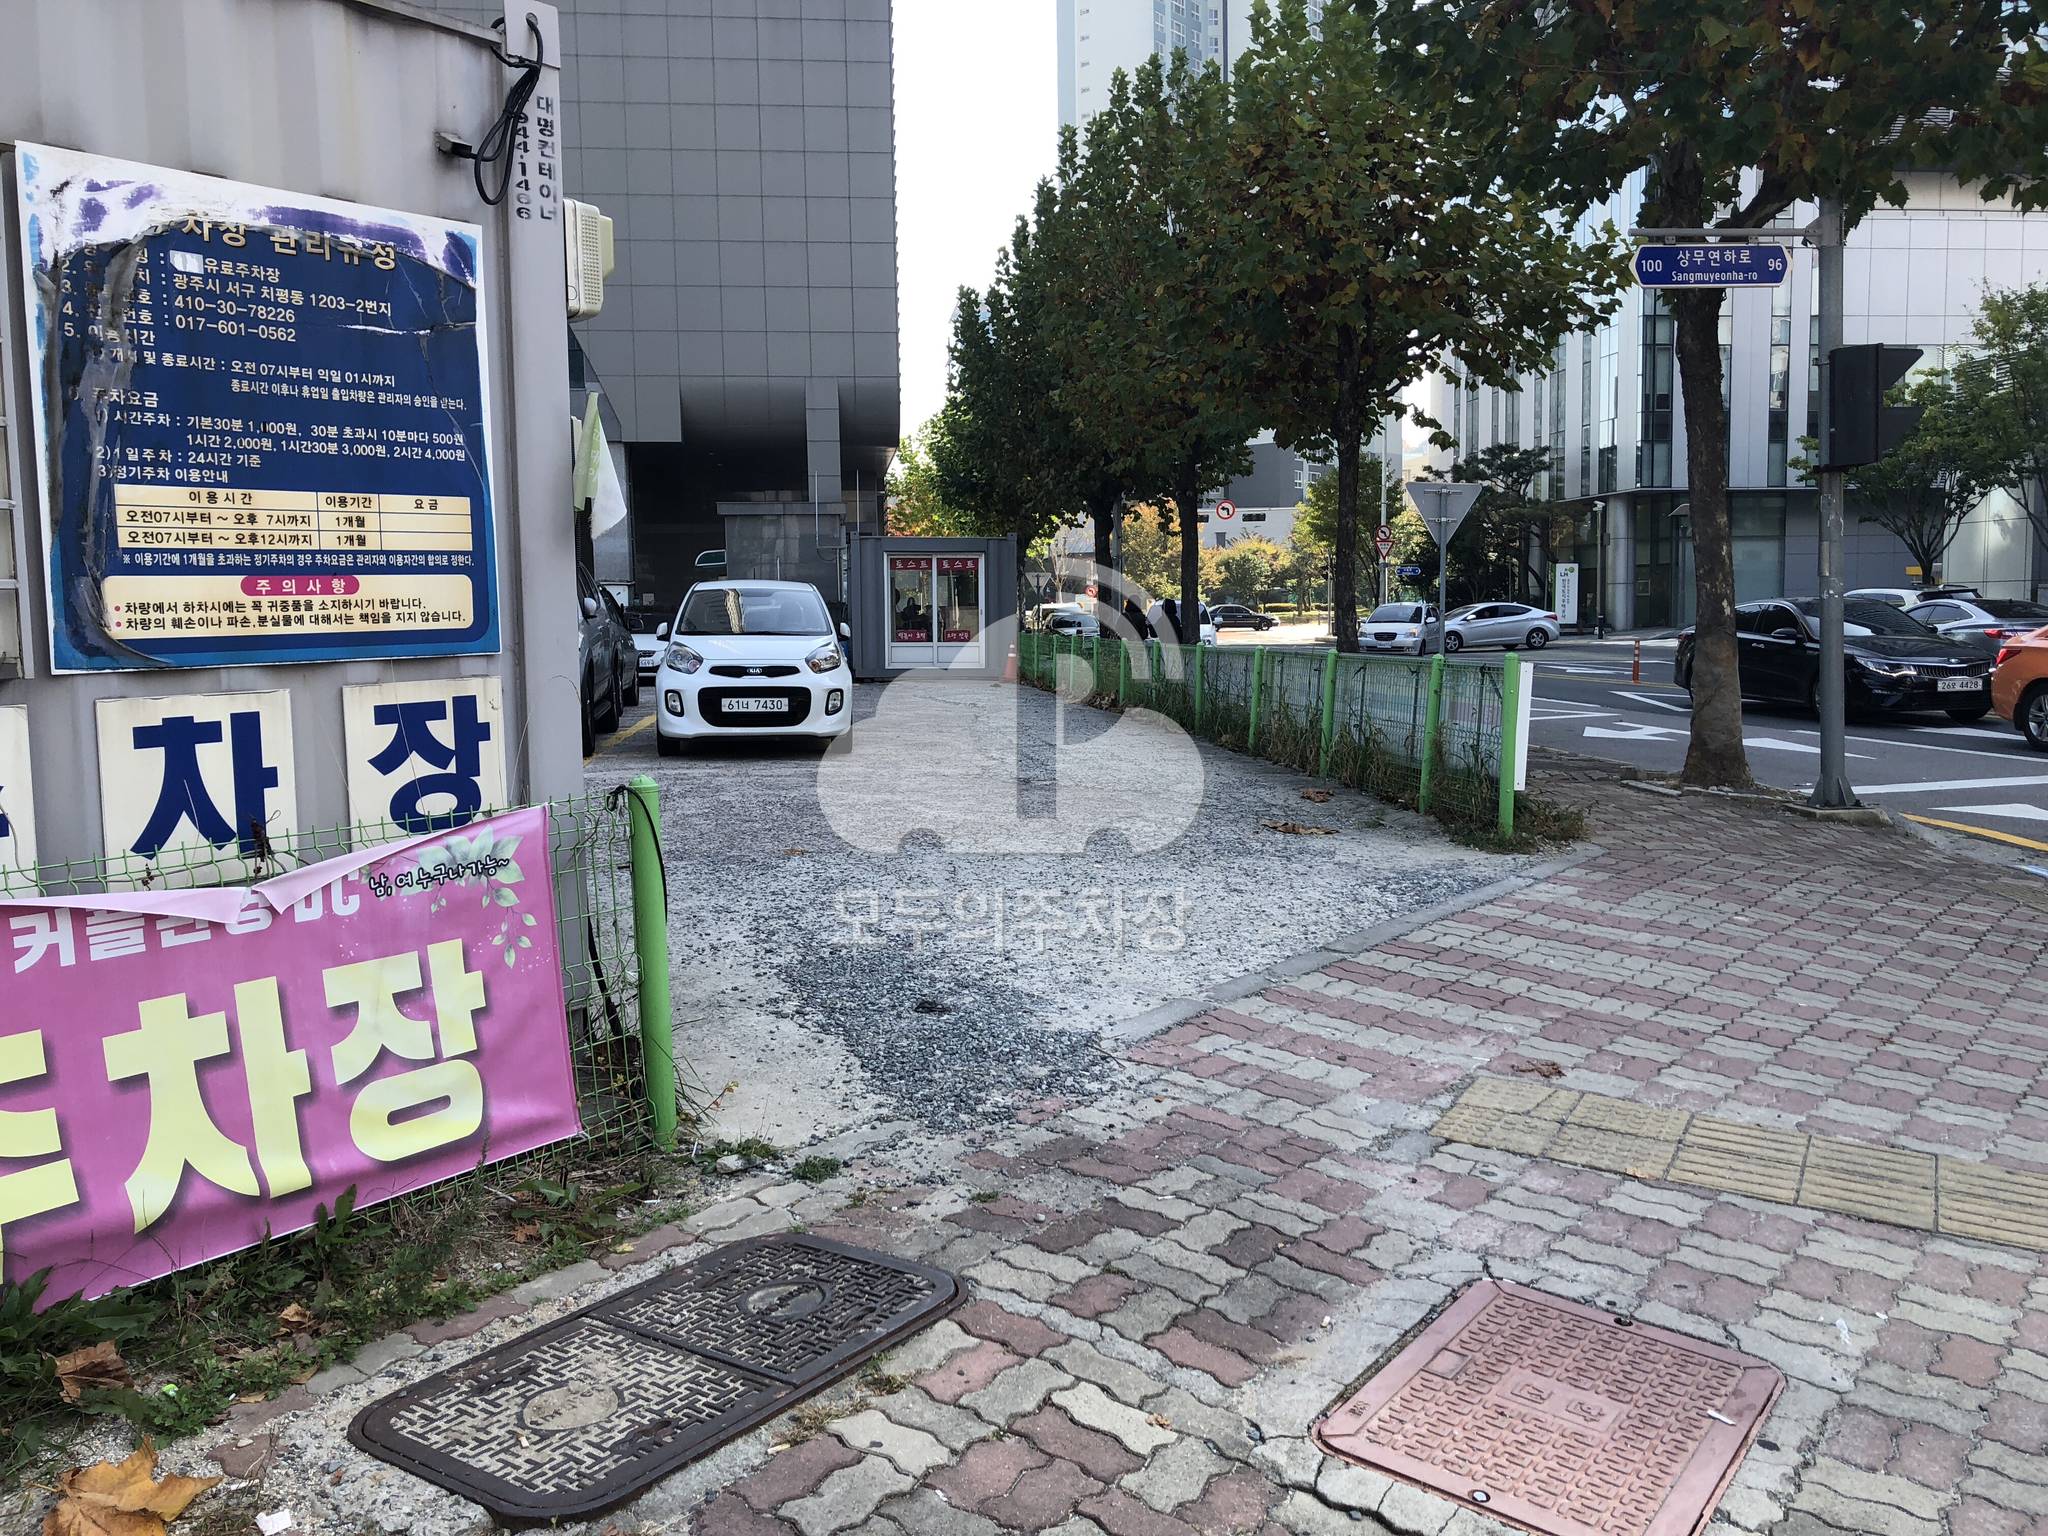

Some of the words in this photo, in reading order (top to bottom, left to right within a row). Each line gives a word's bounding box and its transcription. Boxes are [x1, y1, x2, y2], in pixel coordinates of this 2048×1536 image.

[536, 96, 557, 220] 대명컨테이너
[203, 257, 281, 283] 유료주차장
[1641, 259, 1662, 272] 100
[1677, 250, 1752, 267] 상무연하로
[1767, 258, 1783, 271] 96
[1671, 271, 1758, 283] Sangmuyeonha-ro
[172, 273, 220, 294] 광주시
[225, 280, 256, 298] 서구
[261, 285, 304, 306] 치평동
[309, 293, 392, 317] 1203-2번지
[174, 295, 296, 323] 410-30-78226
[175, 313, 296, 342] 017-601-0562
[143, 350, 156, 366] 및
[161, 353, 216, 371] 종료시간
[230, 359, 257, 376] 오전
[259, 362, 313, 381] 07시부터
[317, 367, 342, 384] 익일
[344, 371, 395, 388] 01시까지
[230, 378, 269, 395] 종료시간
[271, 382, 299, 398] 이후나
[301, 384, 329, 400] 휴업일
[331, 387, 375, 404] 출입차량은
[377, 391, 412, 407] 관리자의
[413, 394, 438, 409] 승인을
[114, 409, 171, 428] 시간주차
[186, 415, 244, 433] 기본30분
[310, 425, 339, 439] 30분
[342, 425, 377, 440] 초과시
[381, 429, 429, 443] 10분마다
[432, 432, 464, 446] 500원
[186, 433, 221, 449] 1시간
[280, 440, 339, 455] 1시간30분
[393, 446, 422, 460] 2시간
[187, 451, 232, 467] 24시간
[236, 453, 262, 468] 기준
[115, 465, 170, 482] 정기주차
[174, 468, 229, 484] 이용안내
[325, 495, 372, 509] 이용기간
[125, 510, 212, 525] 오전07시부터
[233, 511, 258, 526] 오후
[266, 514, 311, 527] 7시까지
[335, 515, 366, 528] 1개월
[127, 531, 213, 545] 오전07시부터
[234, 532, 313, 546] 오후12시까지
[336, 534, 366, 547] 1개월
[134, 553, 181, 566] 이용기간에
[183, 553, 215, 567] 1개월을
[217, 553, 251, 567] 초과하는
[254, 553, 295, 567] 정기주차의
[296, 553, 313, 567] 경우
[315, 554, 354, 567] 주차요금은
[356, 554, 387, 567] 관리자와
[388, 554, 426, 567] 이용자간의
[427, 554, 449, 567] 합의로
[896, 560, 929, 568] 토스트
[942, 559, 975, 568] 토스트
[255, 578, 346, 596] 주의사항
[124, 601, 178, 615] 차량에서
[183, 599, 247, 614] 하차시에는
[251, 600, 263, 613] 꼭
[266, 598, 313, 613] 귀중품을
[318, 598, 375, 611] 소지하시기
[378, 597, 426, 610] 바랍니다.
[125, 617, 166, 631] 차량의
[309, 613, 355, 626] 대해서는
[358, 612, 391, 625] 책임을
[395, 611, 417, 624] 지지
[420, 610, 466, 623] 않습니다.
[1959, 680, 1979, 689] 4428
[727, 699, 750, 711] 61너
[754, 700, 783, 711] 7430
[0, 694, 491, 860] 차장
[416, 863, 467, 890] 누구나
